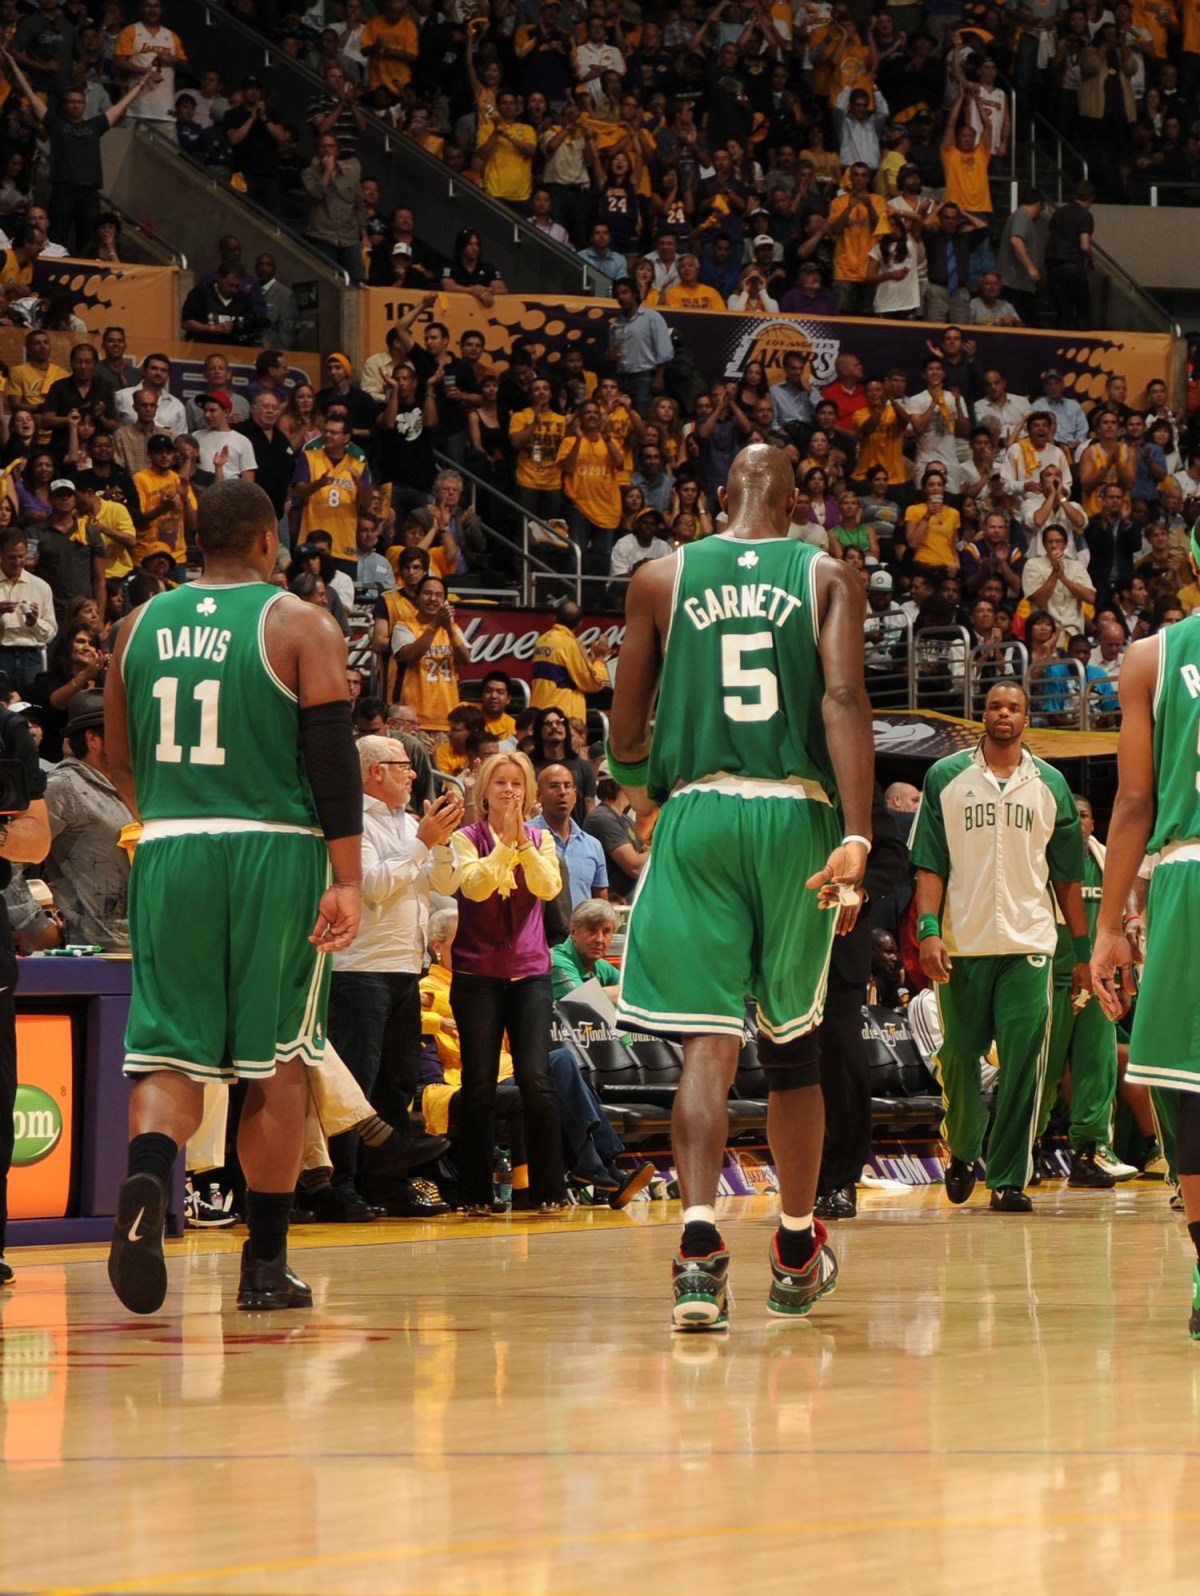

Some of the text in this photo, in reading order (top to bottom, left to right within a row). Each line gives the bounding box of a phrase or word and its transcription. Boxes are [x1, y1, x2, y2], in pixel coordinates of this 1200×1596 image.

[607, 197, 627, 213] 24
[666, 208, 685, 224] 24
[327, 489, 340, 508] 8
[683, 583, 803, 631] GARNETT
[156, 626, 232, 663] DAVIS
[425, 658, 452, 683] 24
[721, 631, 778, 722] 5
[152, 677, 226, 766] 11
[964, 802, 1035, 832] BOSTON
